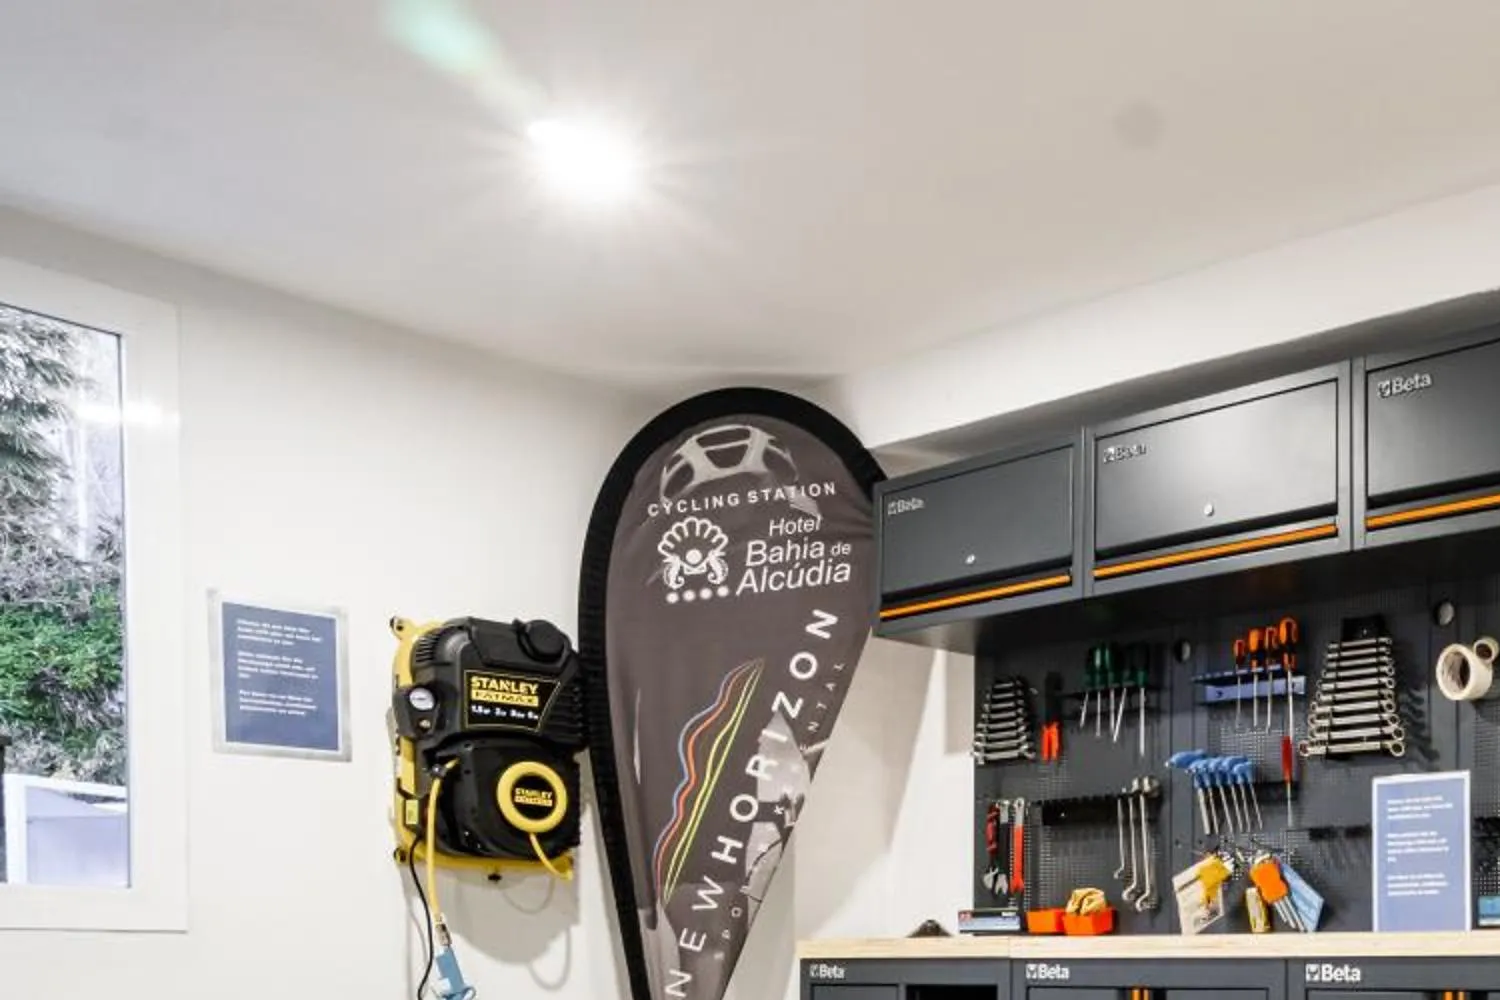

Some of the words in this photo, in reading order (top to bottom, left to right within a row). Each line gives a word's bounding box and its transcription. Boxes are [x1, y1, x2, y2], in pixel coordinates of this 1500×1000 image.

[1392, 373, 1432, 395] Beta
[647, 493, 740, 517] CYCLING
[747, 482, 836, 503] STATION
[768, 514, 822, 537] Hotel
[745, 538, 825, 567] Bahia
[830, 542, 852, 555] de
[735, 559, 852, 596] Alcúdia
[471, 676, 539, 694] STANLEY
[819, 963, 845, 979] Beta
[1038, 963, 1070, 980] Beta
[1321, 963, 1361, 981] Beta
